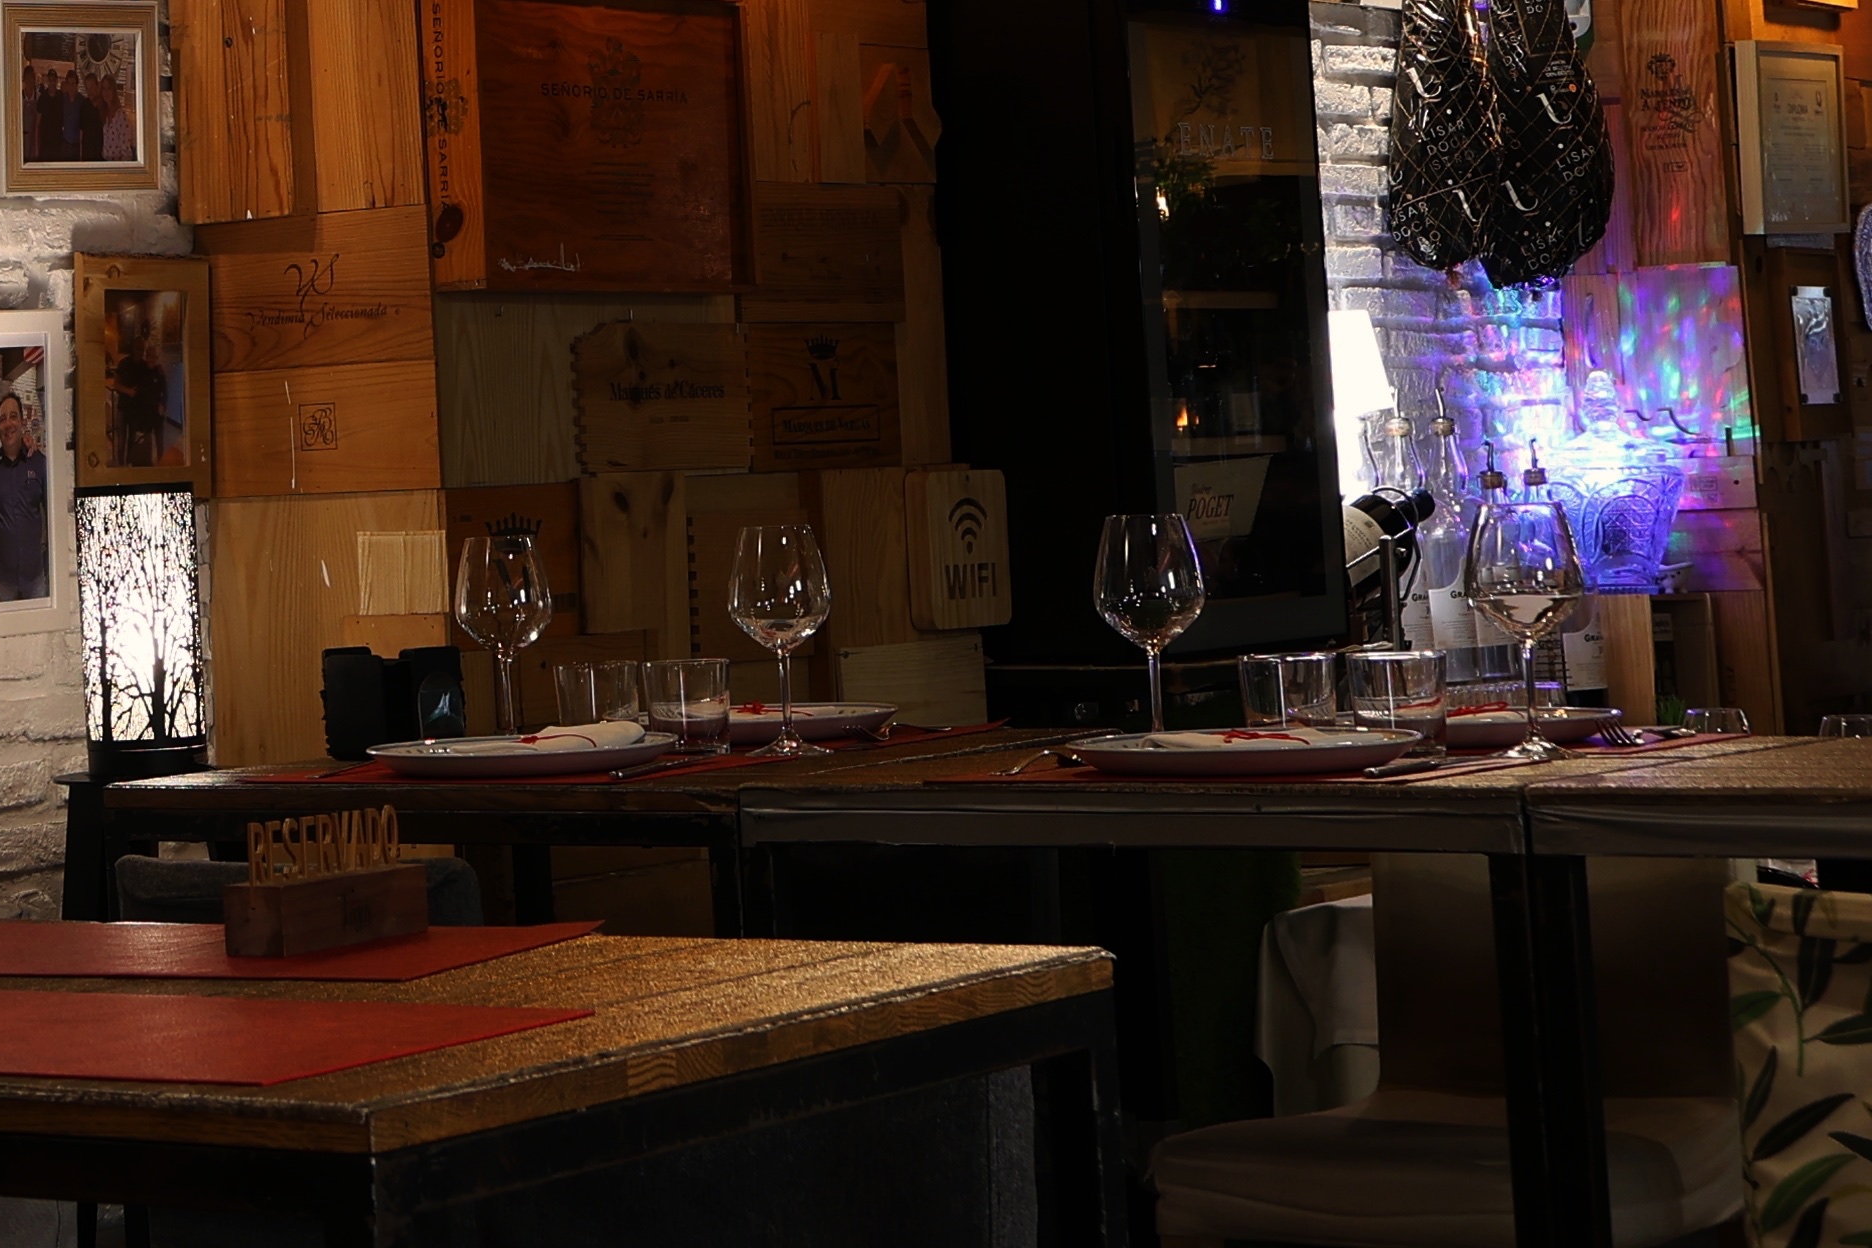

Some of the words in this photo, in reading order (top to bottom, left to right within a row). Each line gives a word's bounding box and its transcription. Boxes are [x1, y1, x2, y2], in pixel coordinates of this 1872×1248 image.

[1178, 121, 1275, 161] ENATE
[245, 309, 306, 332] Vendimia
[664, 381, 677, 400] de
[678, 379, 726, 399] Cáceres
[807, 360, 843, 401] M
[1186, 494, 1235, 521] POGET
[945, 562, 997, 601] WIFI
[246, 803, 400, 888] RESERVADO
